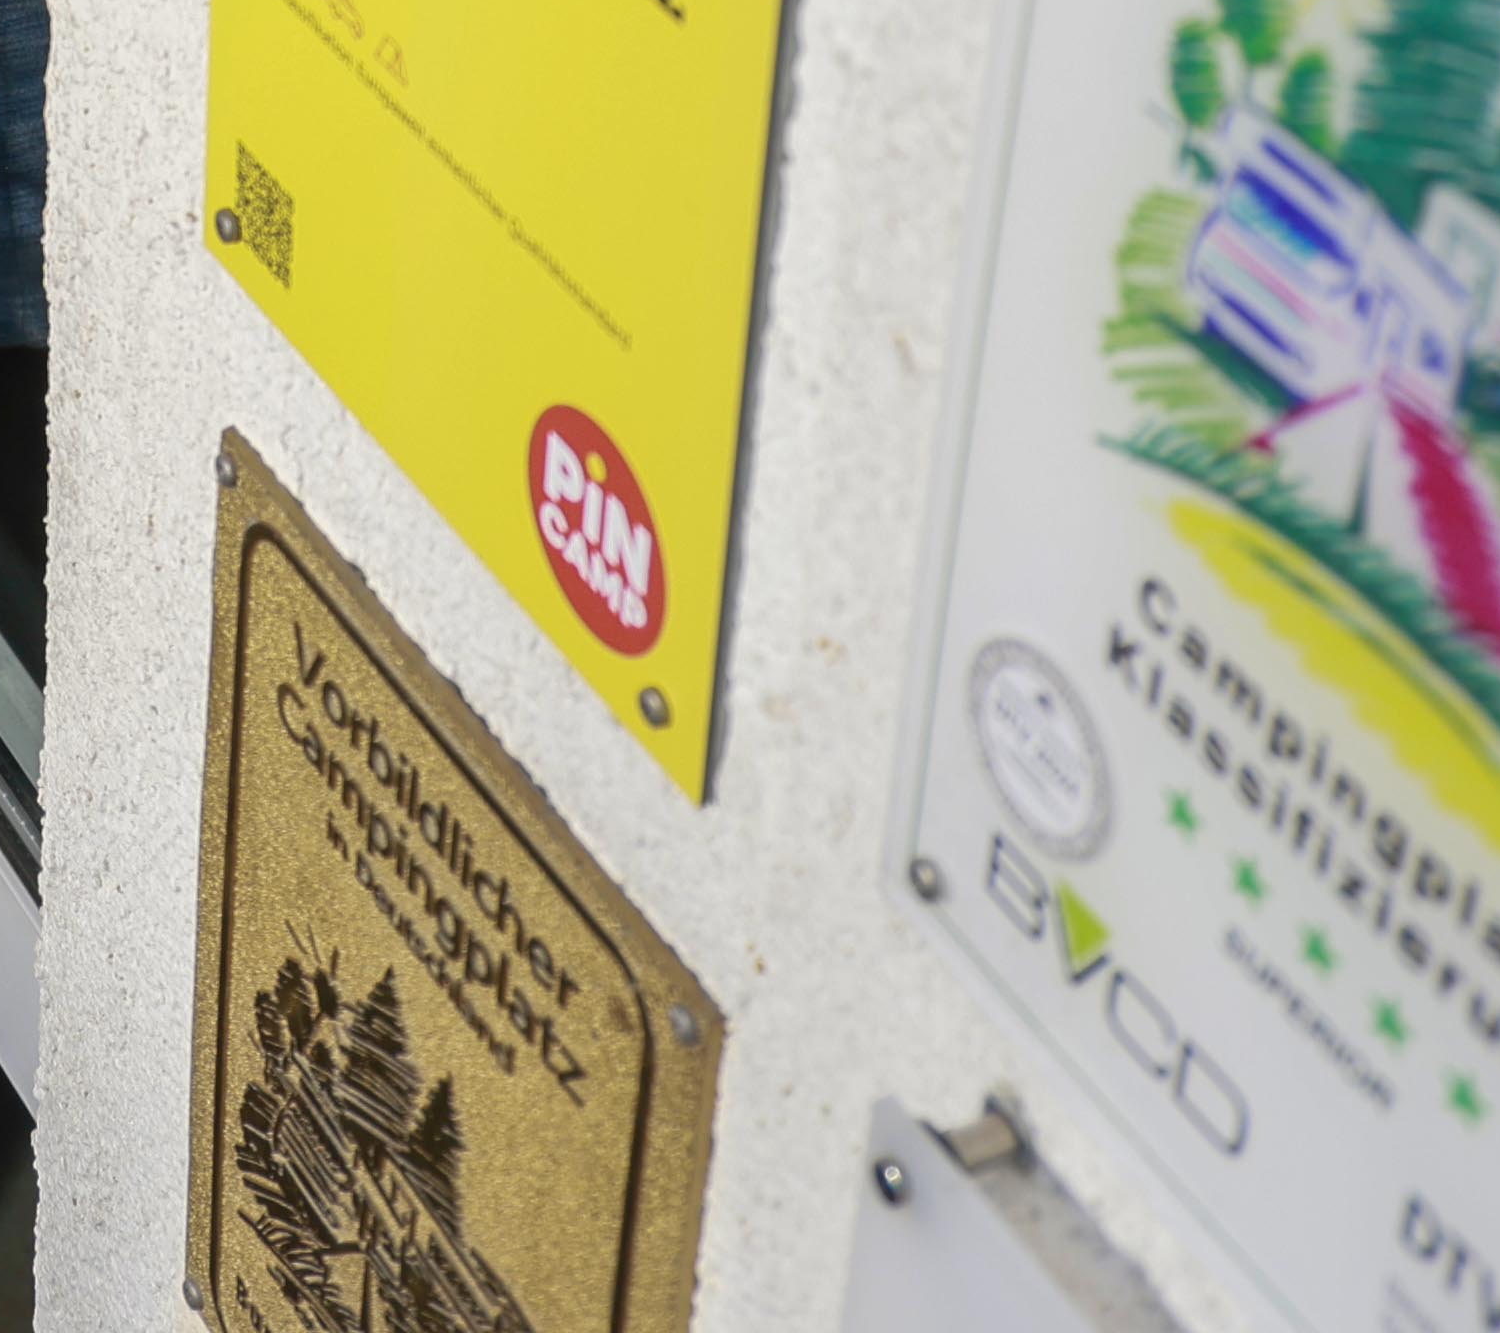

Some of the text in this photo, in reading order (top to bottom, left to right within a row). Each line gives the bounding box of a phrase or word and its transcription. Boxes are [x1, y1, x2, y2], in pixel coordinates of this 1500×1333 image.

[539, 502, 648, 629] CAMP
[277, 682, 588, 1108] Campingplatz
[294, 620, 581, 1008] Vorbildlicher
[327, 810, 348, 862] in
